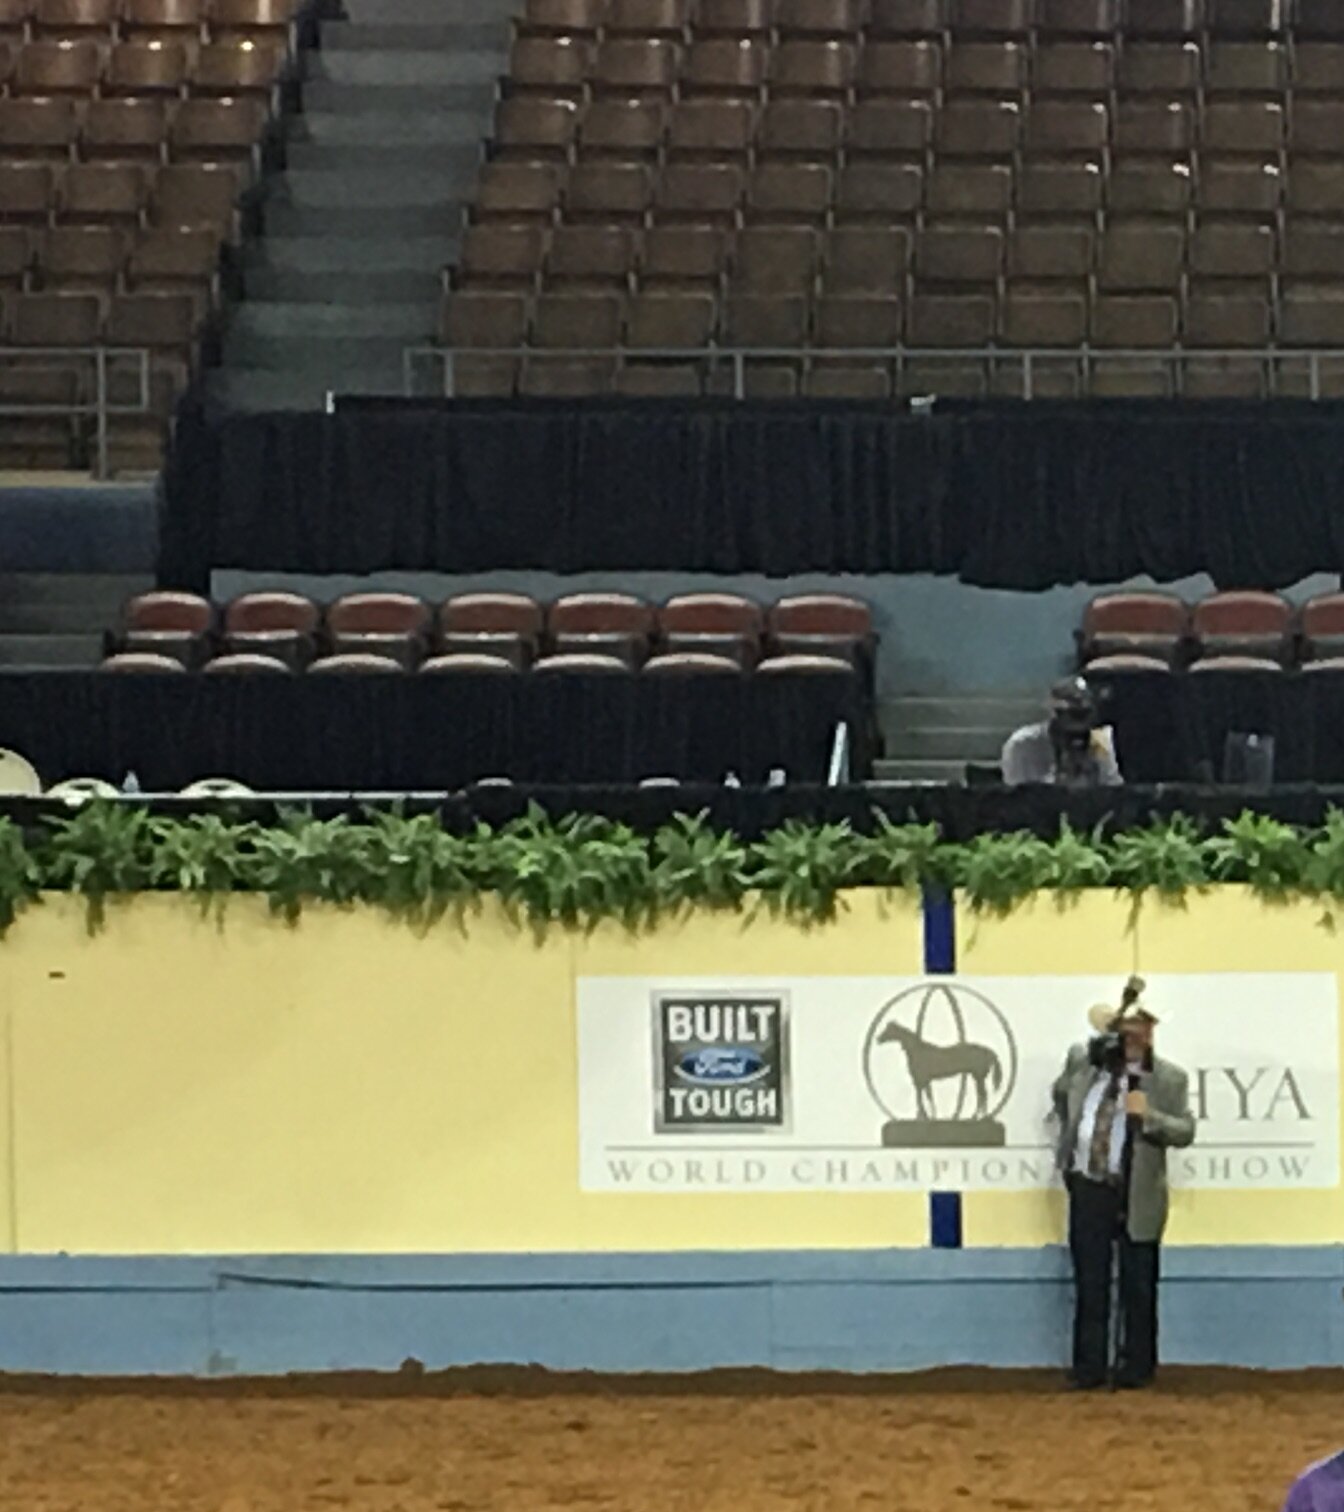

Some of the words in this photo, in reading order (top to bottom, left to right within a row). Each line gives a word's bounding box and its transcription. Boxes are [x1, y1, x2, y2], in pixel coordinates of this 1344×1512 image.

[668, 1004, 776, 1042] BUILT
[668, 1087, 777, 1118] TOUGH
[606, 1158, 766, 1184] WORLD
[791, 1158, 1044, 1184] CHAMPION
[1182, 1156, 1311, 1180] SHOW
